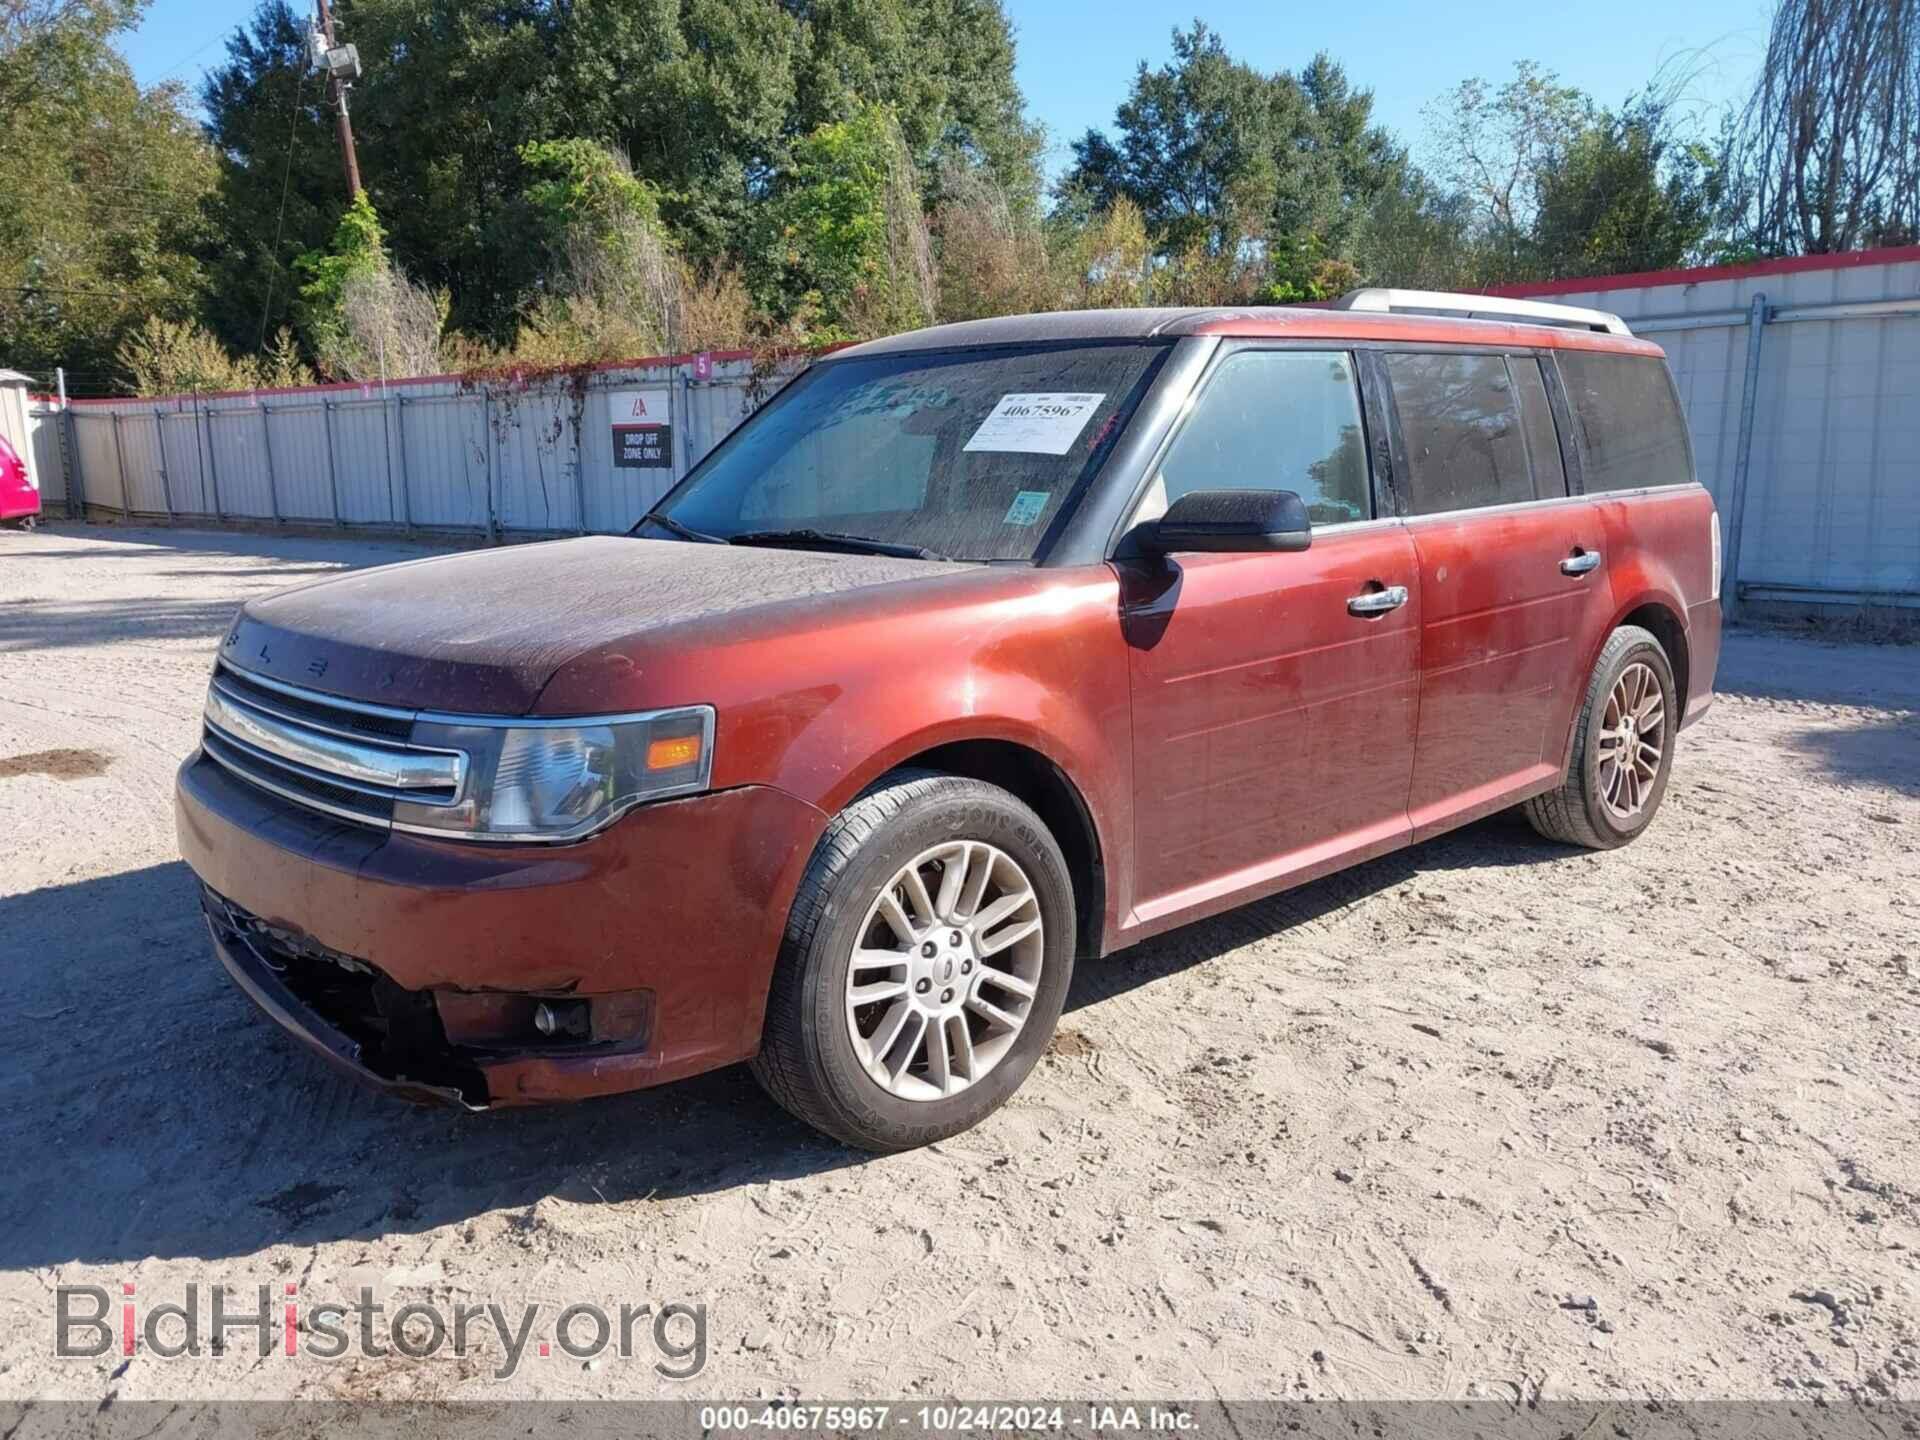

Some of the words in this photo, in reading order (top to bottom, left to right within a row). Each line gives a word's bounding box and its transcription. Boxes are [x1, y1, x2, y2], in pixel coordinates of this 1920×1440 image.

[699, 356, 706, 374] 5
[1001, 405, 1085, 417] 40675967
[625, 434, 644, 445] DROP
[645, 433, 658, 445] OFF
[624, 448, 642, 459] ZONE
[643, 448, 662, 459] ONLY
